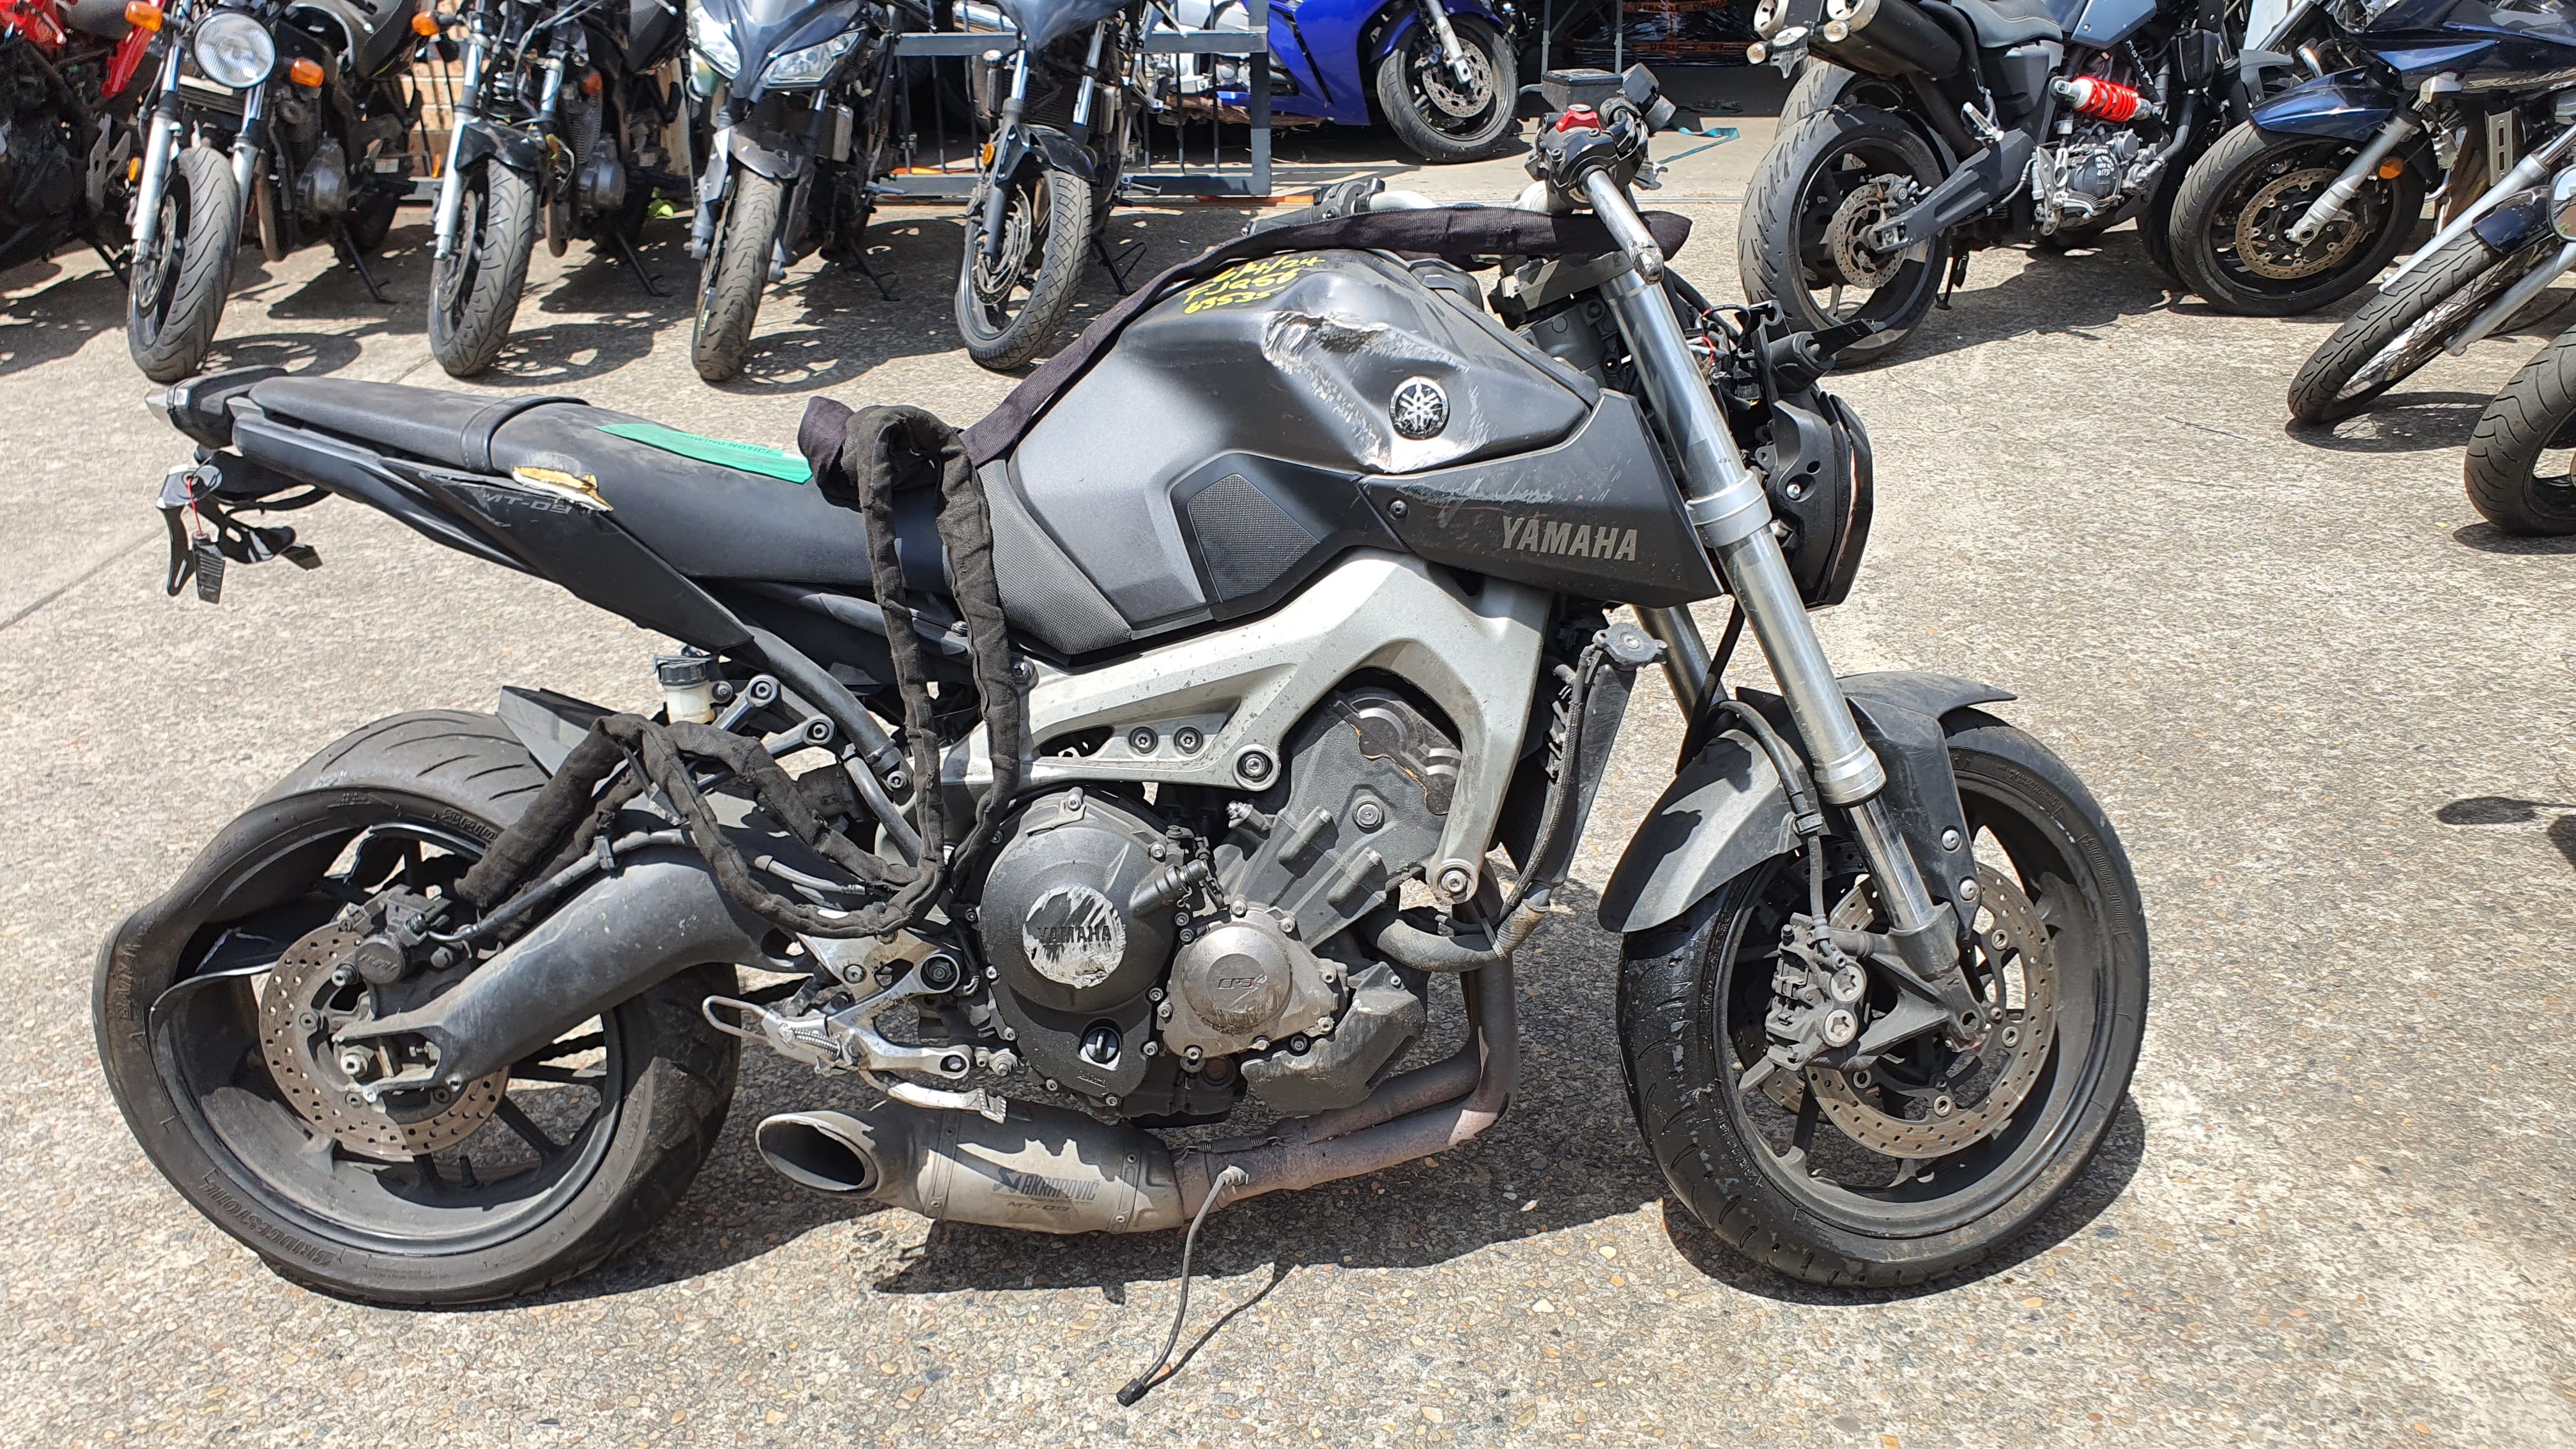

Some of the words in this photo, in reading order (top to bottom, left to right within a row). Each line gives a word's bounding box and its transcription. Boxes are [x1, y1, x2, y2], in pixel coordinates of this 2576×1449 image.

[485, 493, 573, 516] MT-09
[1502, 515, 1638, 562] YAMAHA
[1038, 925, 1112, 944] YAMAHA
